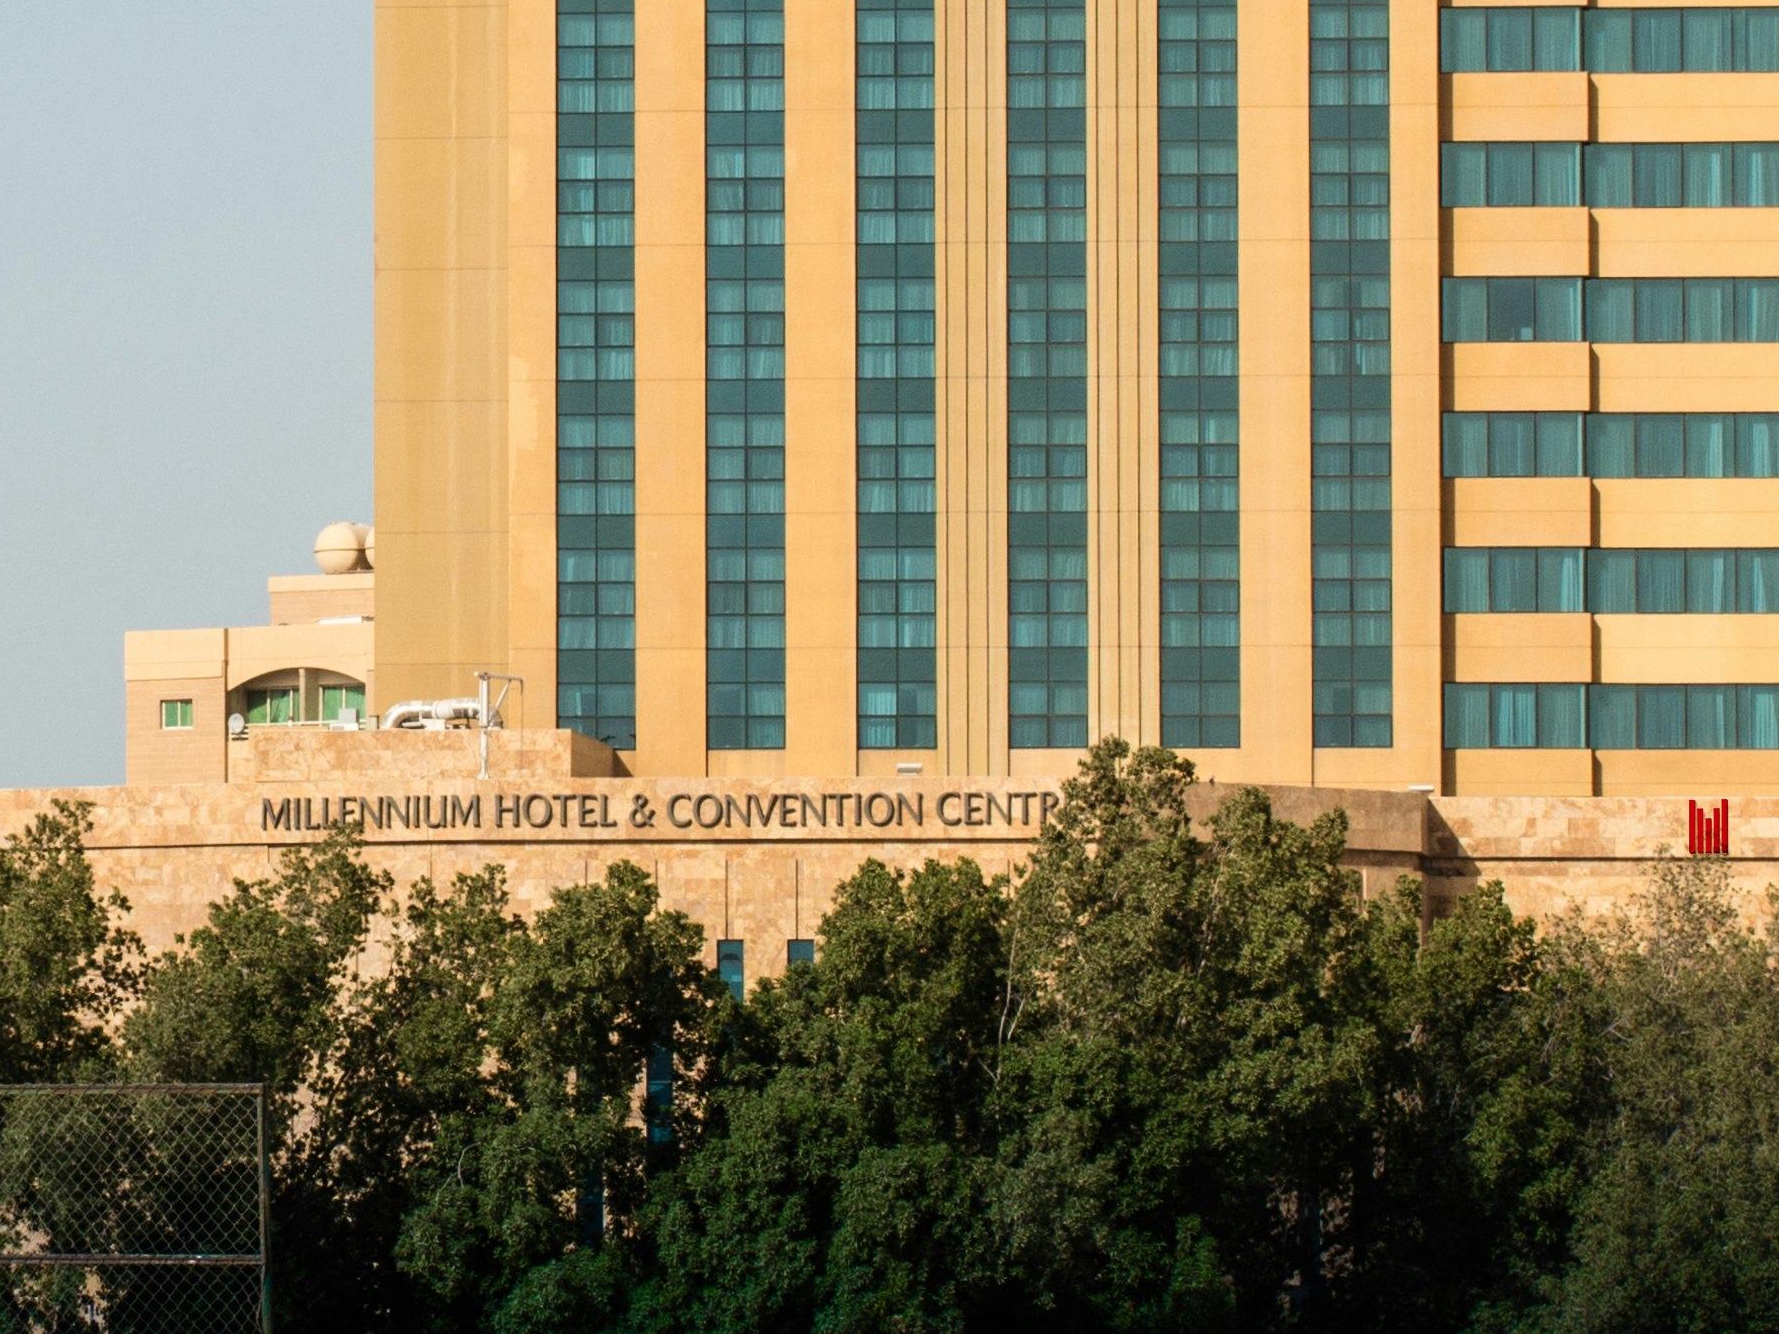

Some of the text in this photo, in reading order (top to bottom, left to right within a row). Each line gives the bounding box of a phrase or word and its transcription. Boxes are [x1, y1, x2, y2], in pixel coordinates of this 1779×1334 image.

[261, 790, 1066, 832] MILLENNIUM HOTEL & CONVENTION CENTR
